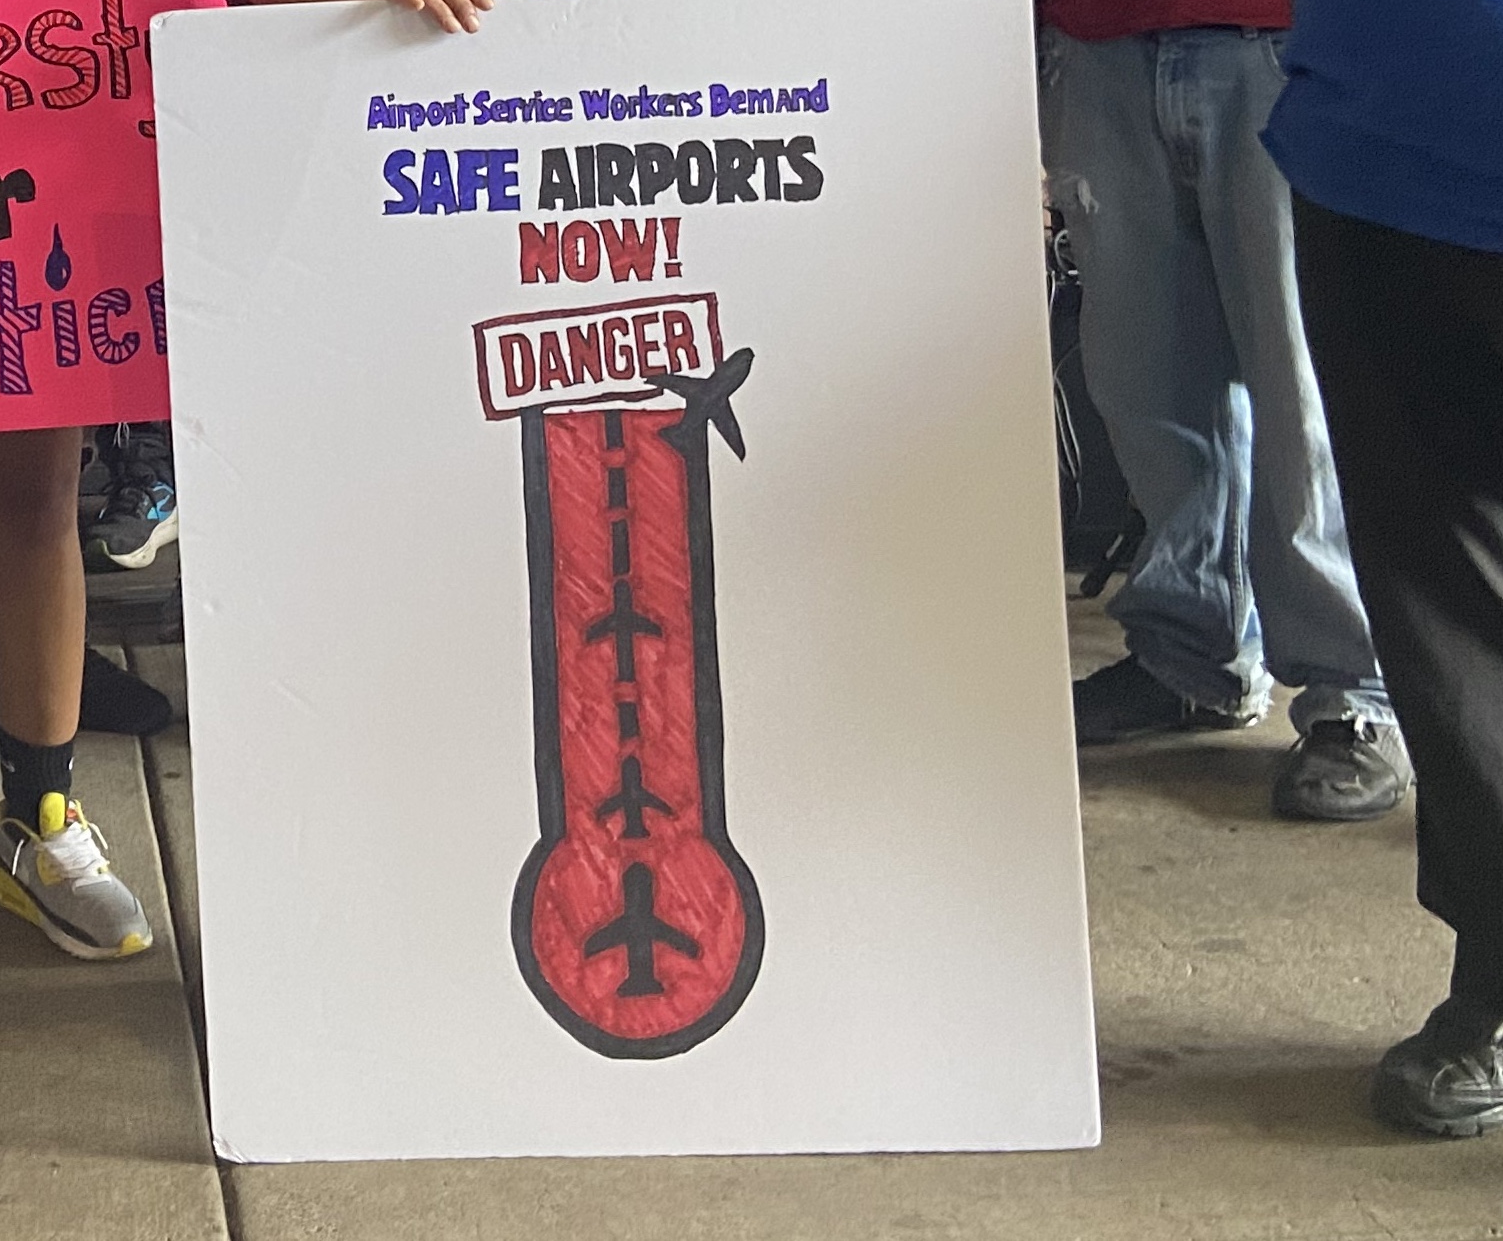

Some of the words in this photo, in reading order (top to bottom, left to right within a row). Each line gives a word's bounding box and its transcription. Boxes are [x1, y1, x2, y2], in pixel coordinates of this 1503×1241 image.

[367, 93, 470, 132] Airport
[471, 90, 573, 126] Service
[581, 84, 702, 122] Workers
[382, 147, 521, 215] SAFE
[537, 136, 824, 211] AIRPORTS
[518, 217, 683, 285] NOW!
[497, 309, 701, 398] DANGER
